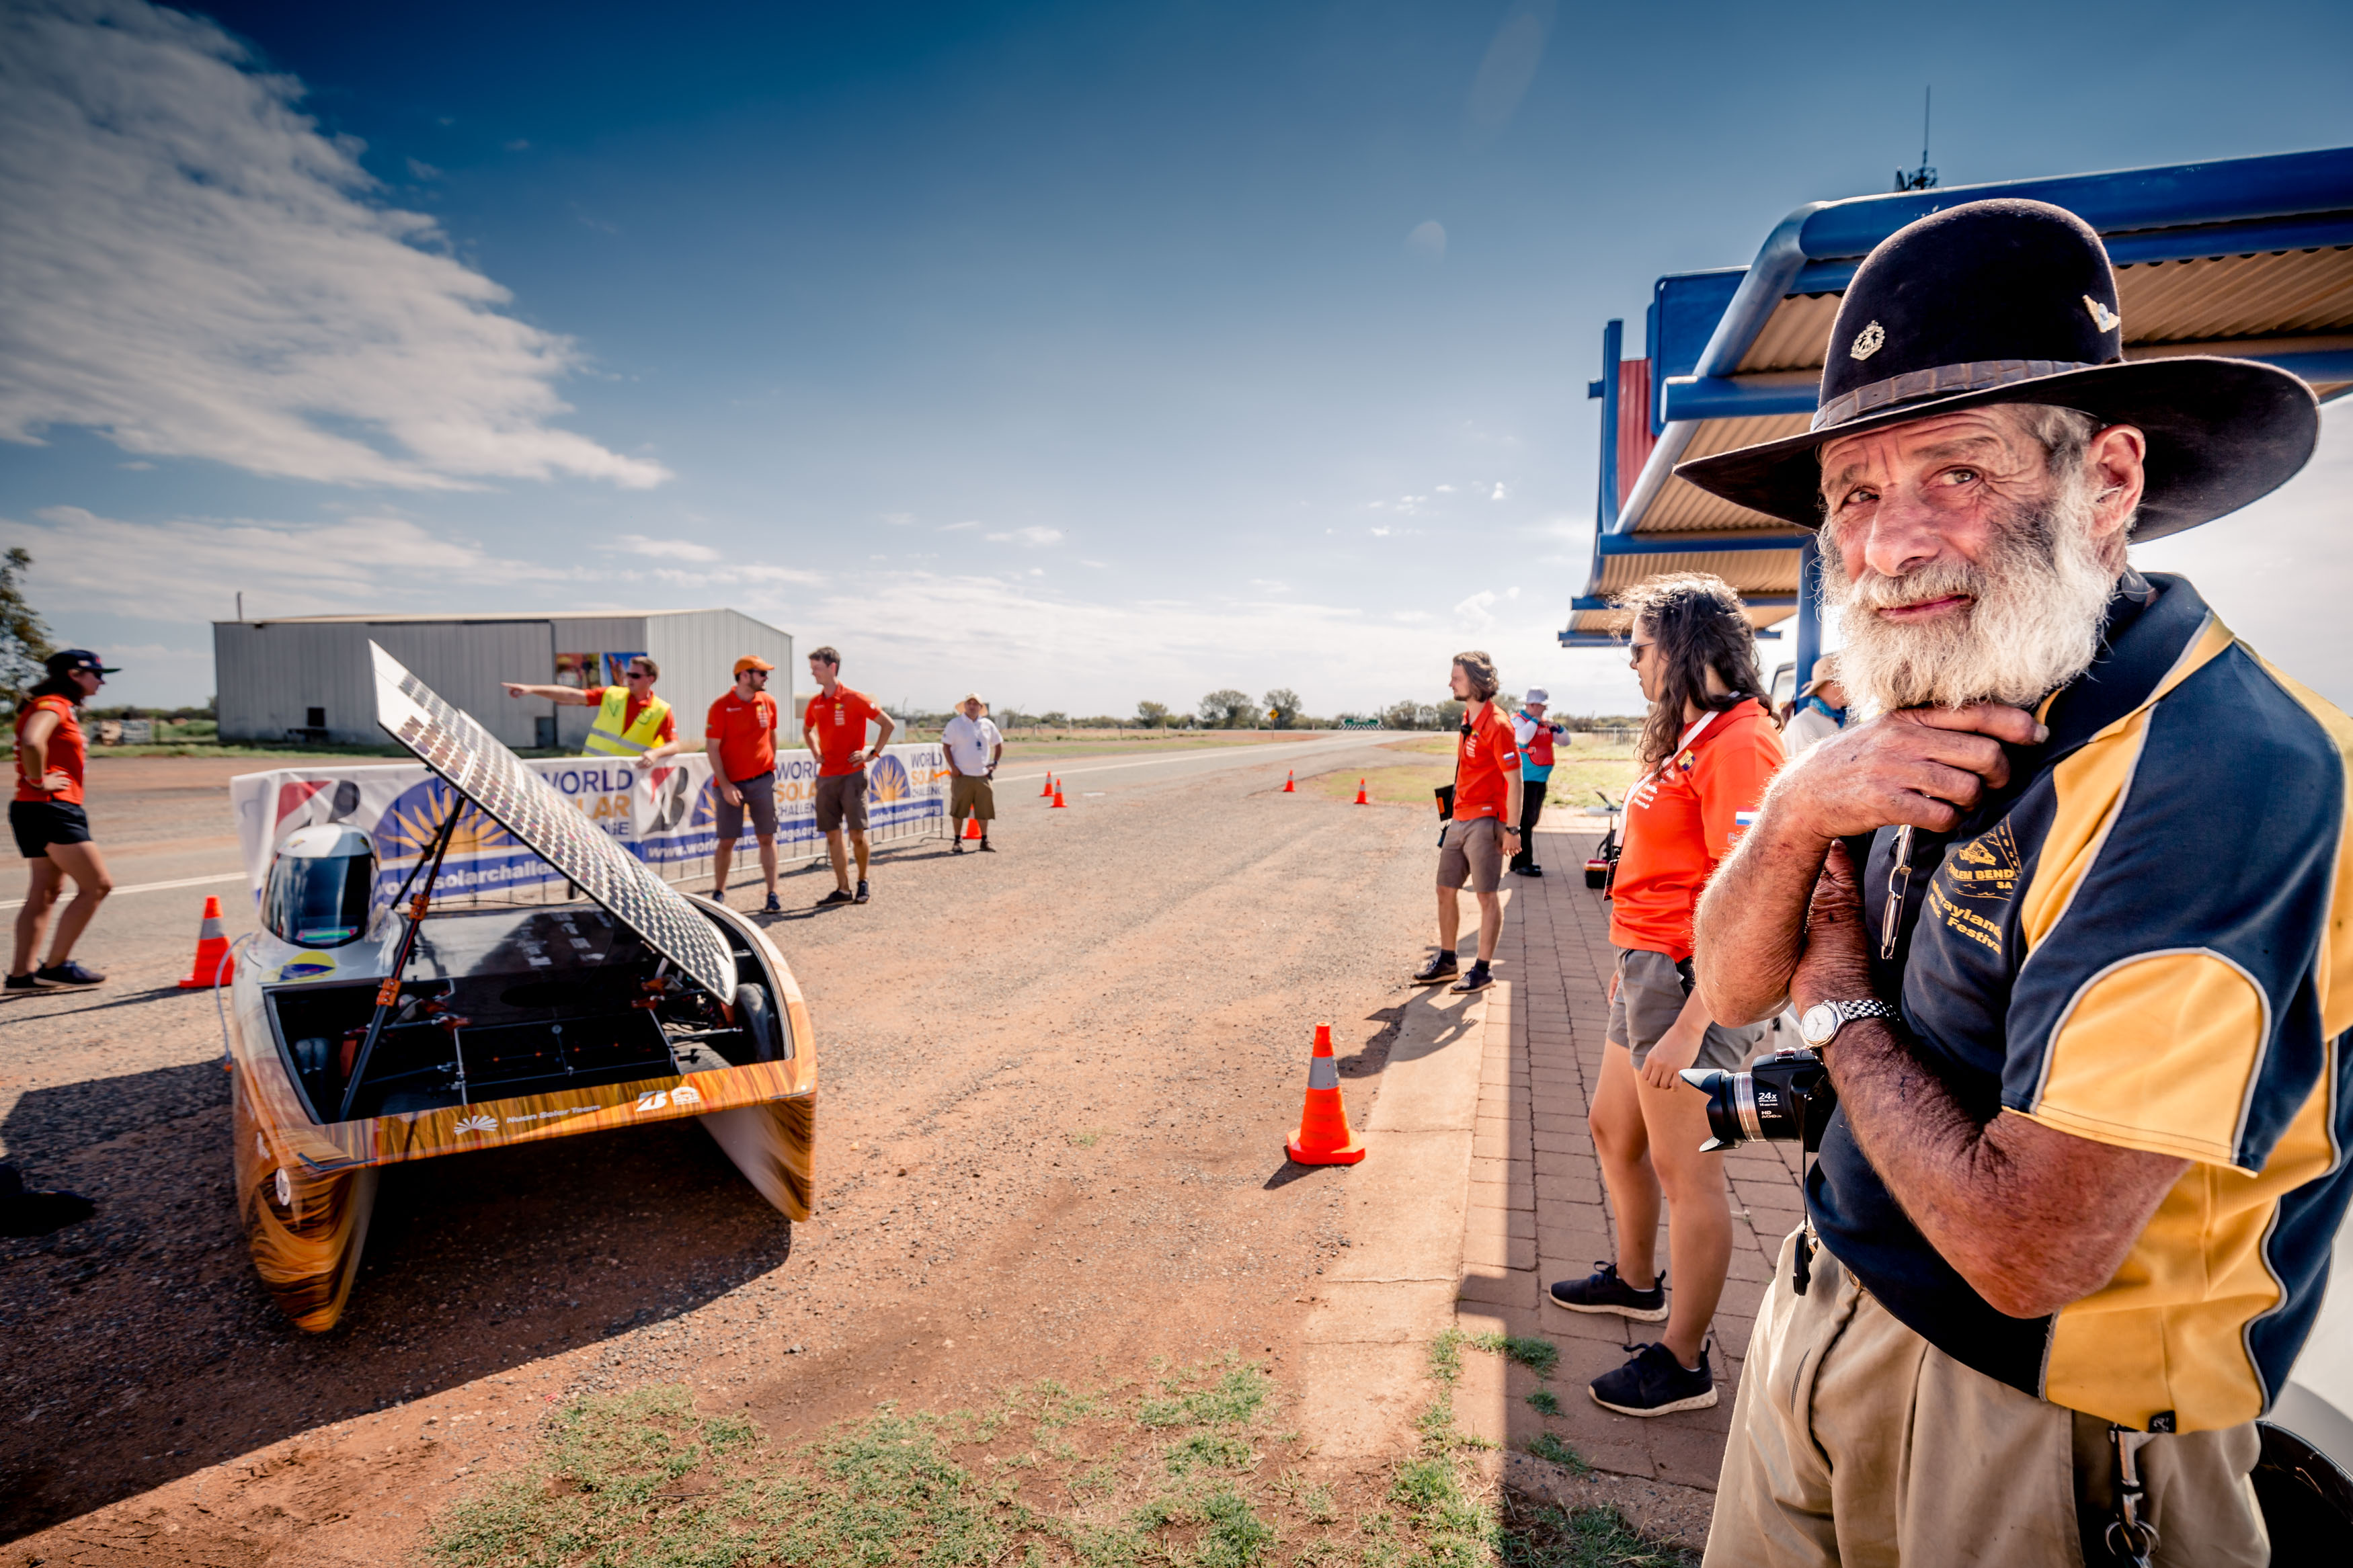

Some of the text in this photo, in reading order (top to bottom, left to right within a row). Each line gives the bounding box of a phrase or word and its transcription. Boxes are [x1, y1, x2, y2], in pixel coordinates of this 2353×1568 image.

[775, 761, 818, 780] WORL
[775, 782, 818, 803] SOLA
[577, 794, 631, 819] LAR
[776, 802, 817, 817] HALLEN
[1975, 869, 2015, 880] BEND
[1996, 880, 2013, 889] SA
[1946, 916, 2001, 955] Festiva
[1758, 1092, 1778, 1100] 24x
[506, 1104, 601, 1124] Nuon Solar Team
